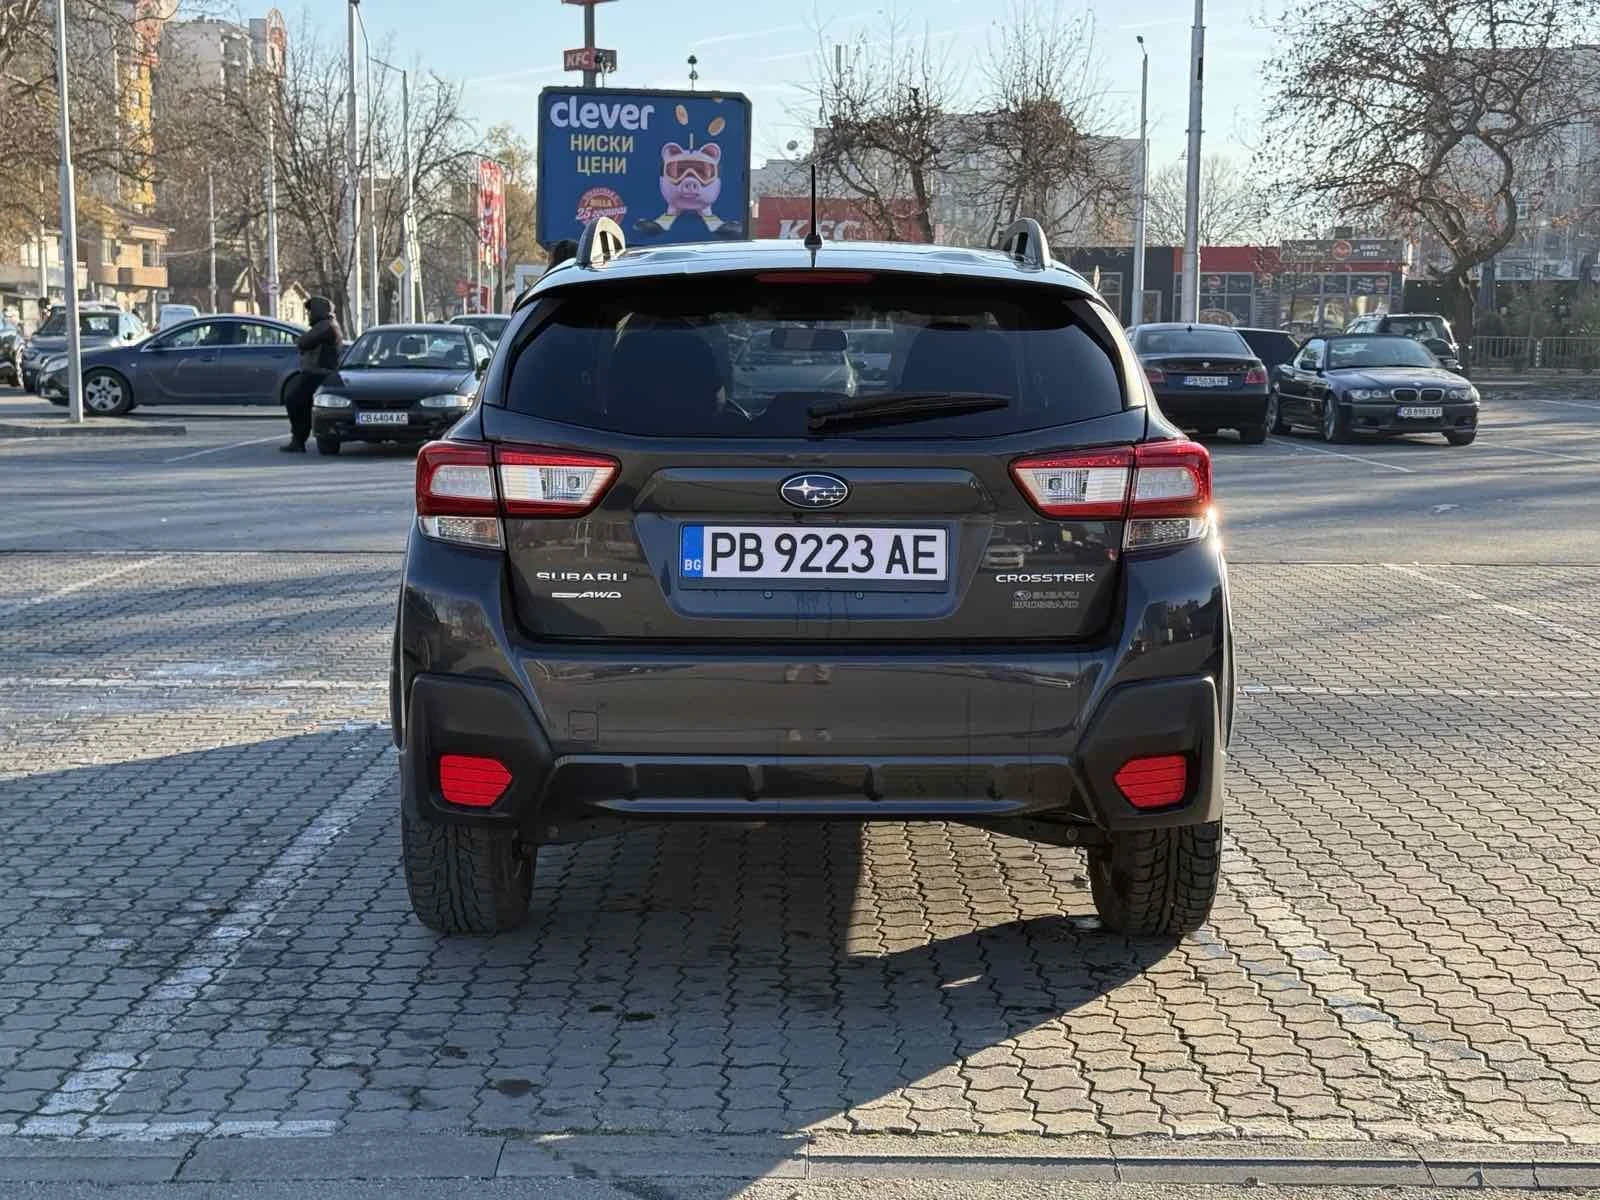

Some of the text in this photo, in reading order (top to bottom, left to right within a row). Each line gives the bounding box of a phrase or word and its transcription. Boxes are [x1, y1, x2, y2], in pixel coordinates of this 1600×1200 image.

[566, 51, 589, 66] KFC
[550, 96, 655, 130] clever
[570, 133, 634, 153] НИСКИ
[576, 155, 627, 176] ЦЕНИ
[576, 207, 592, 220] 25
[778, 219, 861, 240] KFC
[711, 532, 938, 575] PB 9223 AE
[684, 559, 701, 572] BG
[536, 571, 628, 582] SUBARU
[995, 573, 1096, 583] CROSSTREK
[578, 591, 622, 599] AWD
[1031, 590, 1080, 599] SUBARU
